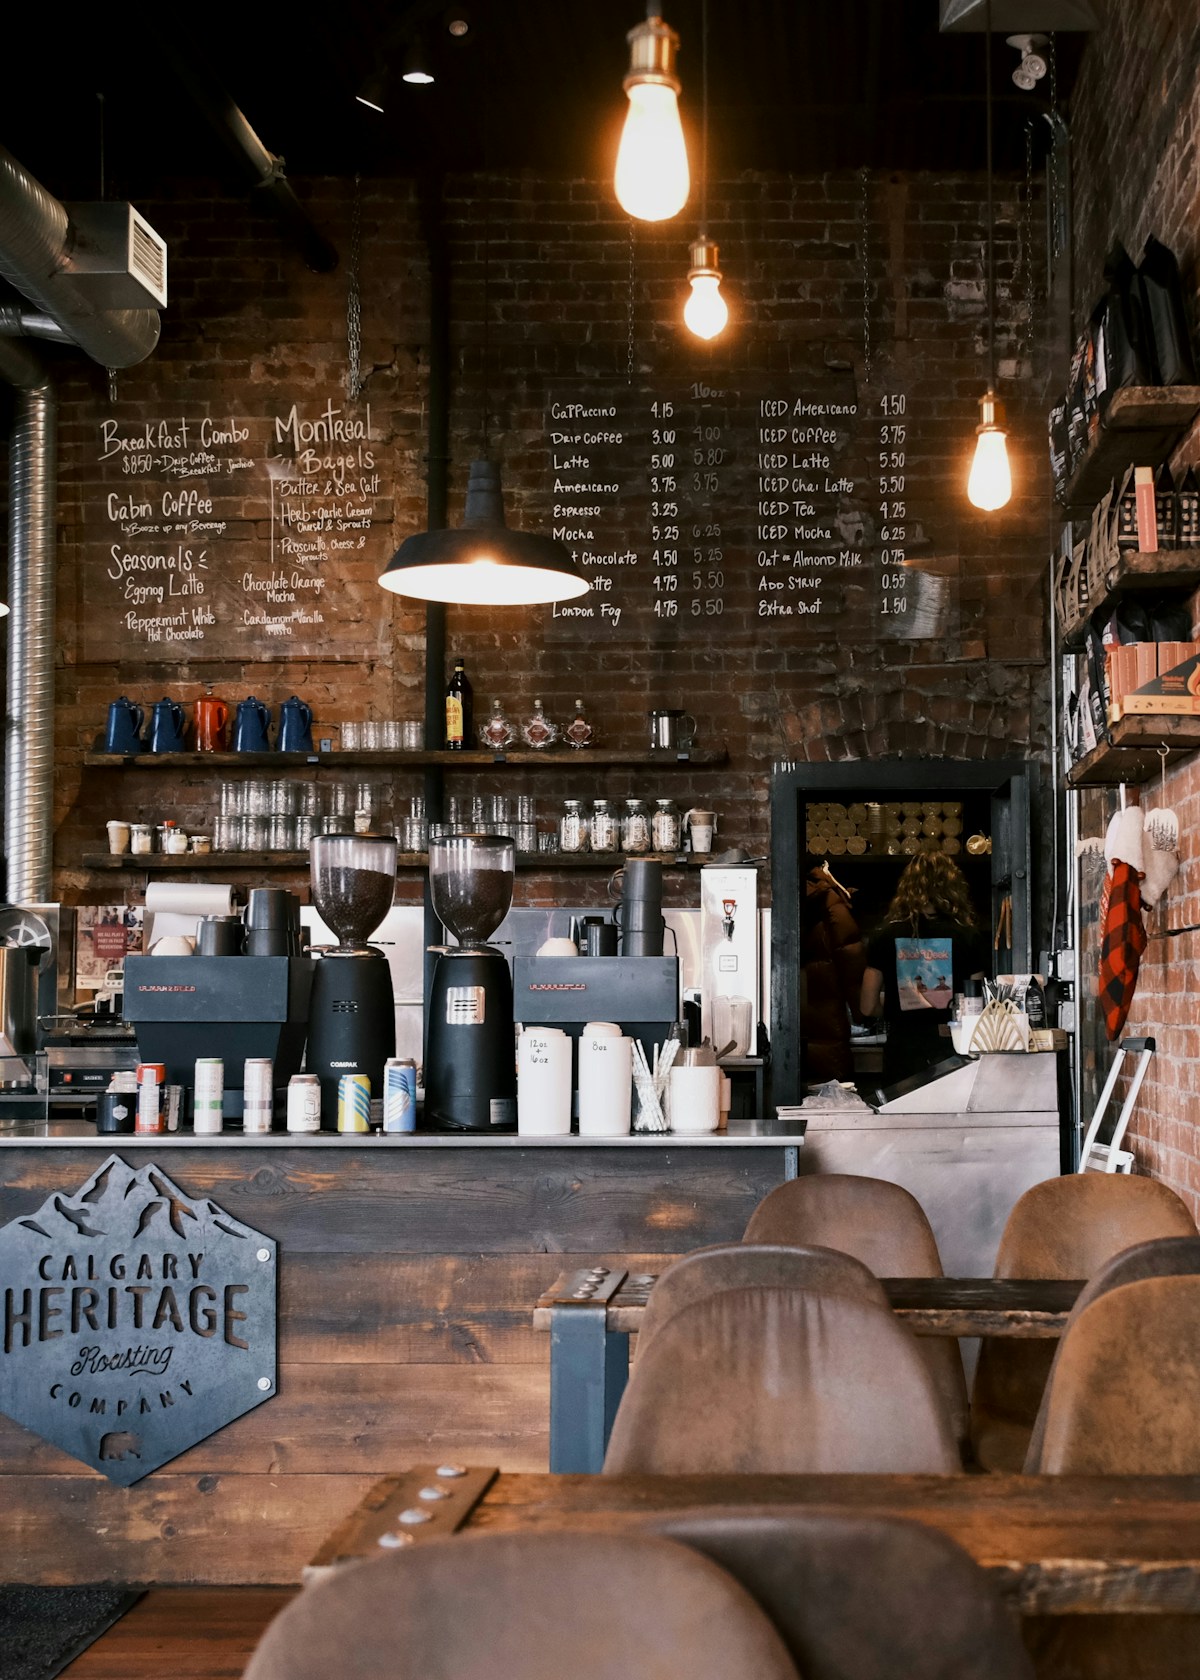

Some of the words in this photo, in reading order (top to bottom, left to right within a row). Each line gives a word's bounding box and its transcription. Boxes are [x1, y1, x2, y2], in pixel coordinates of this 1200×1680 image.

[651, 401, 674, 419] 4.15
[760, 400, 788, 417] ICED
[793, 398, 857, 416] Americano
[880, 394, 906, 415] 4.50
[276, 398, 371, 451] Montreal
[98, 417, 190, 461] Breakfast
[201, 418, 249, 448] Combo
[583, 432, 623, 444] Coffee
[652, 430, 675, 444] 3.00
[760, 428, 787, 443] ICED
[792, 428, 837, 444] Coffee
[880, 425, 906, 444] 3.75
[122, 454, 152, 475] $8.50
[189, 452, 215, 466] Coffee
[178, 459, 222, 479] Breakfast
[300, 445, 375, 482] Bagels
[553, 454, 590, 470] Latte
[651, 454, 674, 468] 5.00
[759, 454, 788, 469] ICED
[792, 453, 830, 469] Latte
[879, 452, 905, 468] 5.50
[279, 478, 320, 497] Butter
[323, 480, 332, 495] &
[335, 481, 357, 497] Sea
[359, 474, 381, 502] Salt
[554, 478, 619, 493] Americano
[651, 476, 676, 492] 3.75
[693, 472, 719, 492] 3.75
[759, 477, 789, 493] ICED
[792, 477, 818, 492] Chai
[825, 477, 854, 493] Latte
[879, 476, 905, 494] 5.50
[107, 492, 152, 521] Cabin
[162, 489, 212, 517] Coffee
[281, 502, 311, 527] Herb
[345, 501, 373, 518] Cream
[553, 504, 600, 518] Espresso
[651, 502, 678, 517] 3.25
[758, 501, 789, 515] ICED
[793, 501, 816, 517] Tea
[879, 502, 906, 519] 4.25
[128, 522, 160, 537] Booze
[162, 525, 172, 534] up
[188, 519, 227, 534] Beverage
[325, 520, 333, 532] &
[336, 517, 372, 532] Sprouts
[553, 526, 594, 541] Mocha
[652, 526, 679, 540] 5.25
[693, 524, 721, 537] 6.25
[758, 525, 788, 539] ICED
[795, 526, 831, 540] Mocha
[881, 527, 905, 541] 6.25
[357, 535, 366, 549] &
[107, 544, 193, 580] Seasonals
[296, 552, 328, 564] Sprouts
[582, 550, 637, 565] Chocolate
[652, 550, 677, 566] 4.50
[694, 548, 723, 564] 5.25
[758, 549, 779, 567] Oat
[793, 551, 836, 567] Almond
[840, 551, 862, 567] Milk
[881, 549, 905, 564] 0.75
[124, 576, 164, 605] Eggnog
[169, 573, 205, 596] Latte
[242, 570, 289, 592] Chocolate
[290, 571, 326, 595] Orange
[589, 575, 612, 591] atte
[653, 575, 677, 592] 4.75
[693, 571, 724, 590] 5.50
[882, 574, 906, 589] 0.55
[266, 589, 296, 603] Mocha
[552, 602, 594, 618] London
[601, 603, 621, 626] Fog
[654, 599, 677, 617] 4.75
[691, 599, 723, 616] 5.50
[758, 600, 793, 616] Extra
[798, 598, 822, 615] Shot
[881, 598, 907, 614] 1.50
[124, 607, 189, 633] Peppermint
[191, 605, 216, 626] White
[147, 627, 163, 642] Hot
[165, 625, 205, 641] Chocolate
[38, 1253, 204, 1281] CALGARY
[4, 1284, 250, 1354] HERITAGE
[70, 1345, 176, 1377] Roasting
[49, 1379, 196, 1416] COMPANY
